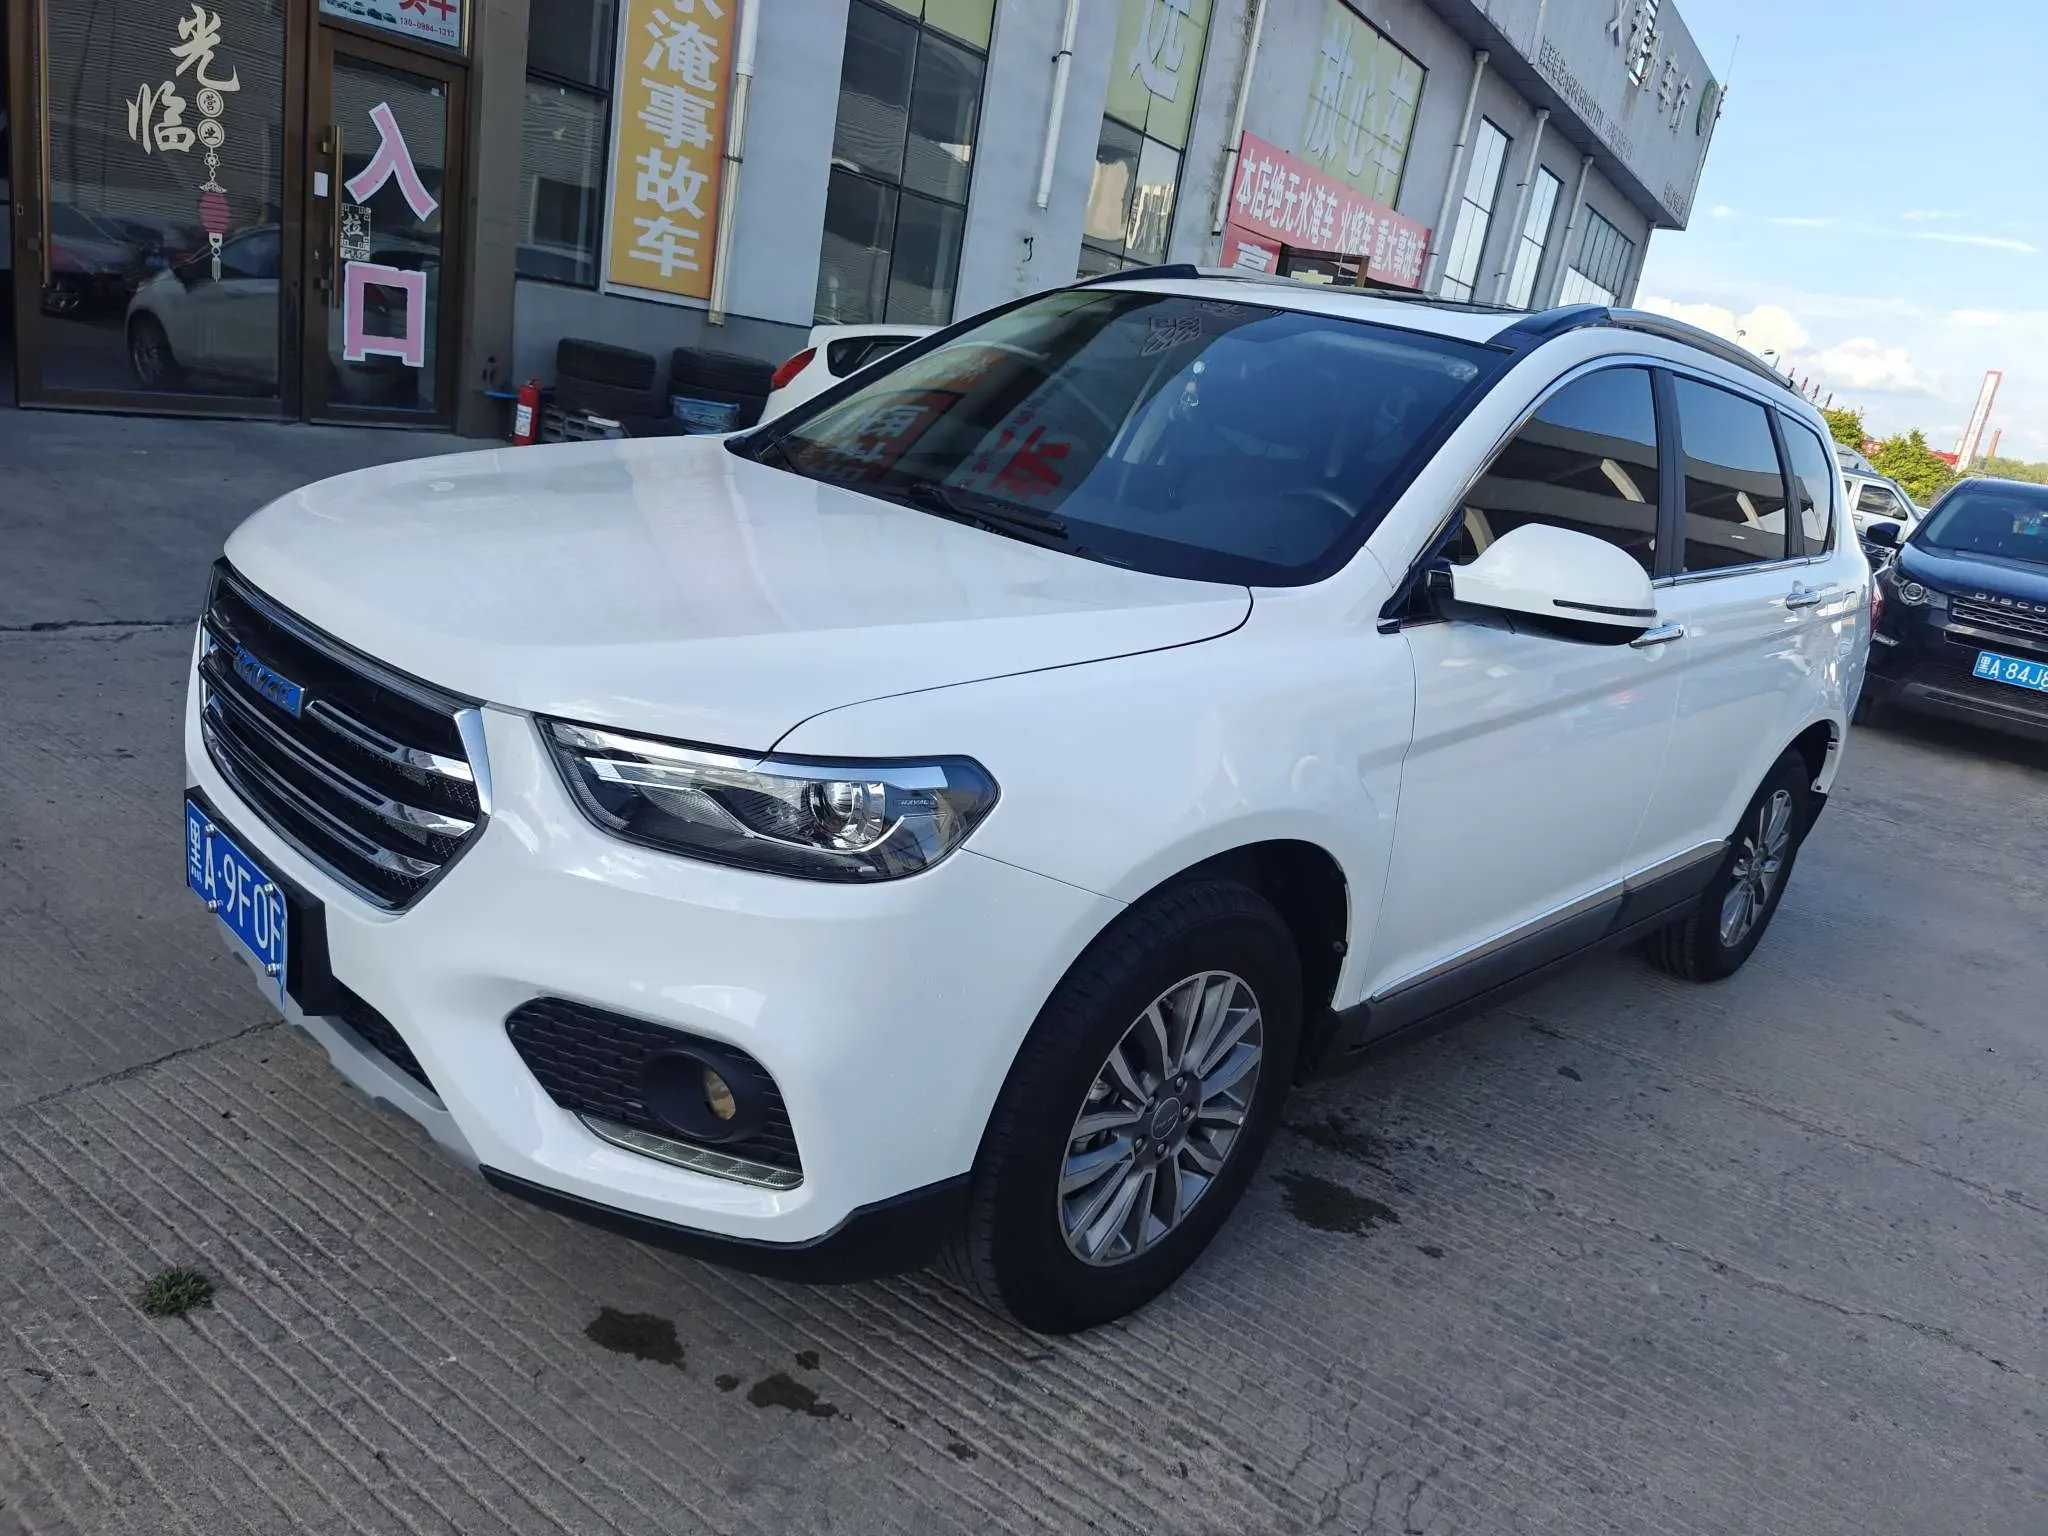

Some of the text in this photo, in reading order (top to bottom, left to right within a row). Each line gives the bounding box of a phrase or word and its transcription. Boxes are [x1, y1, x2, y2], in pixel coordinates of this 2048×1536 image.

[125, 2, 240, 156] 光临
[628, 0, 724, 278] 淹事故车
[1304, 15, 1414, 196] 放心车
[343, 101, 440, 368] 入口
[1371, 219, 1426, 280] 重大事故车
[1975, 592, 2047, 613] DISCO
